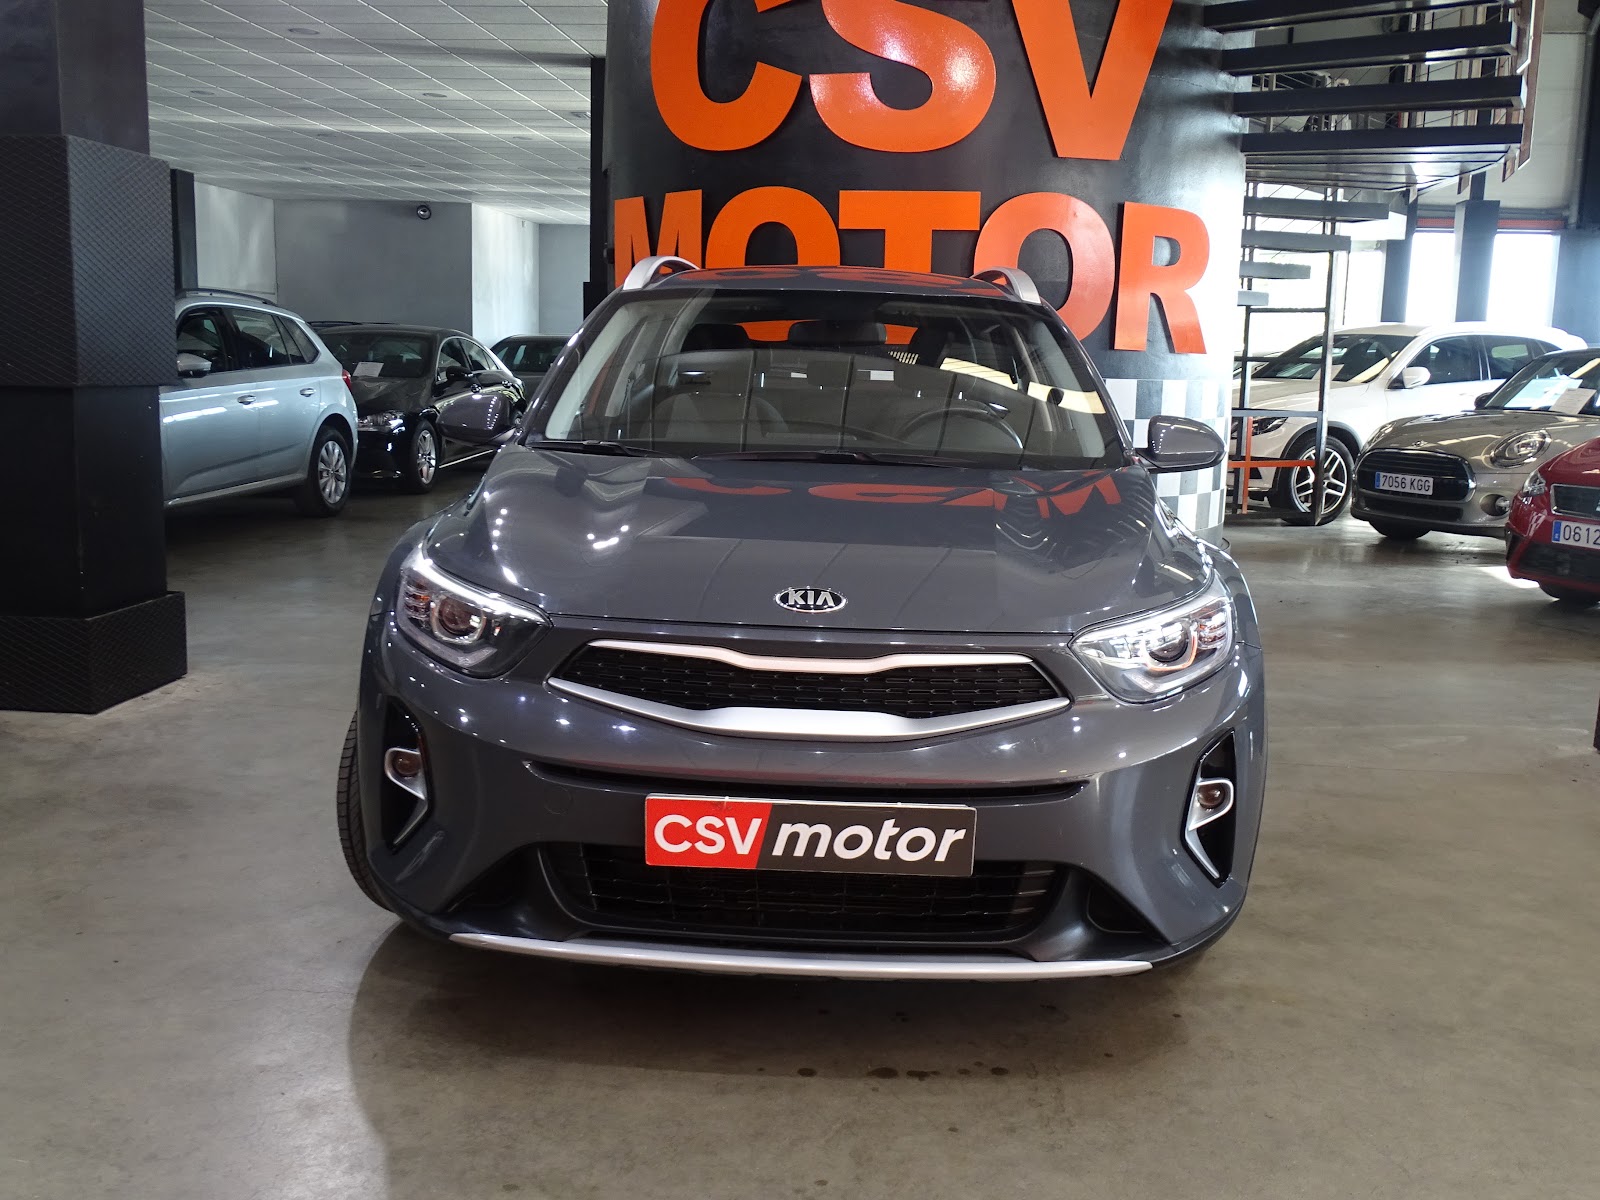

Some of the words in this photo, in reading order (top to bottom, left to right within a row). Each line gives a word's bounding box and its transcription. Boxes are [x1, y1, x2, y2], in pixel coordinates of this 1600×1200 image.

[650, 0, 1172, 161] CSV
[614, 186, 1210, 354] MOTOR
[1381, 474, 1407, 489] 7056
[1409, 478, 1431, 492] KGG
[1563, 524, 1600, 545] 0612
[788, 589, 836, 607] KIA
[653, 813, 763, 855] CSV
[771, 818, 967, 862] motor
